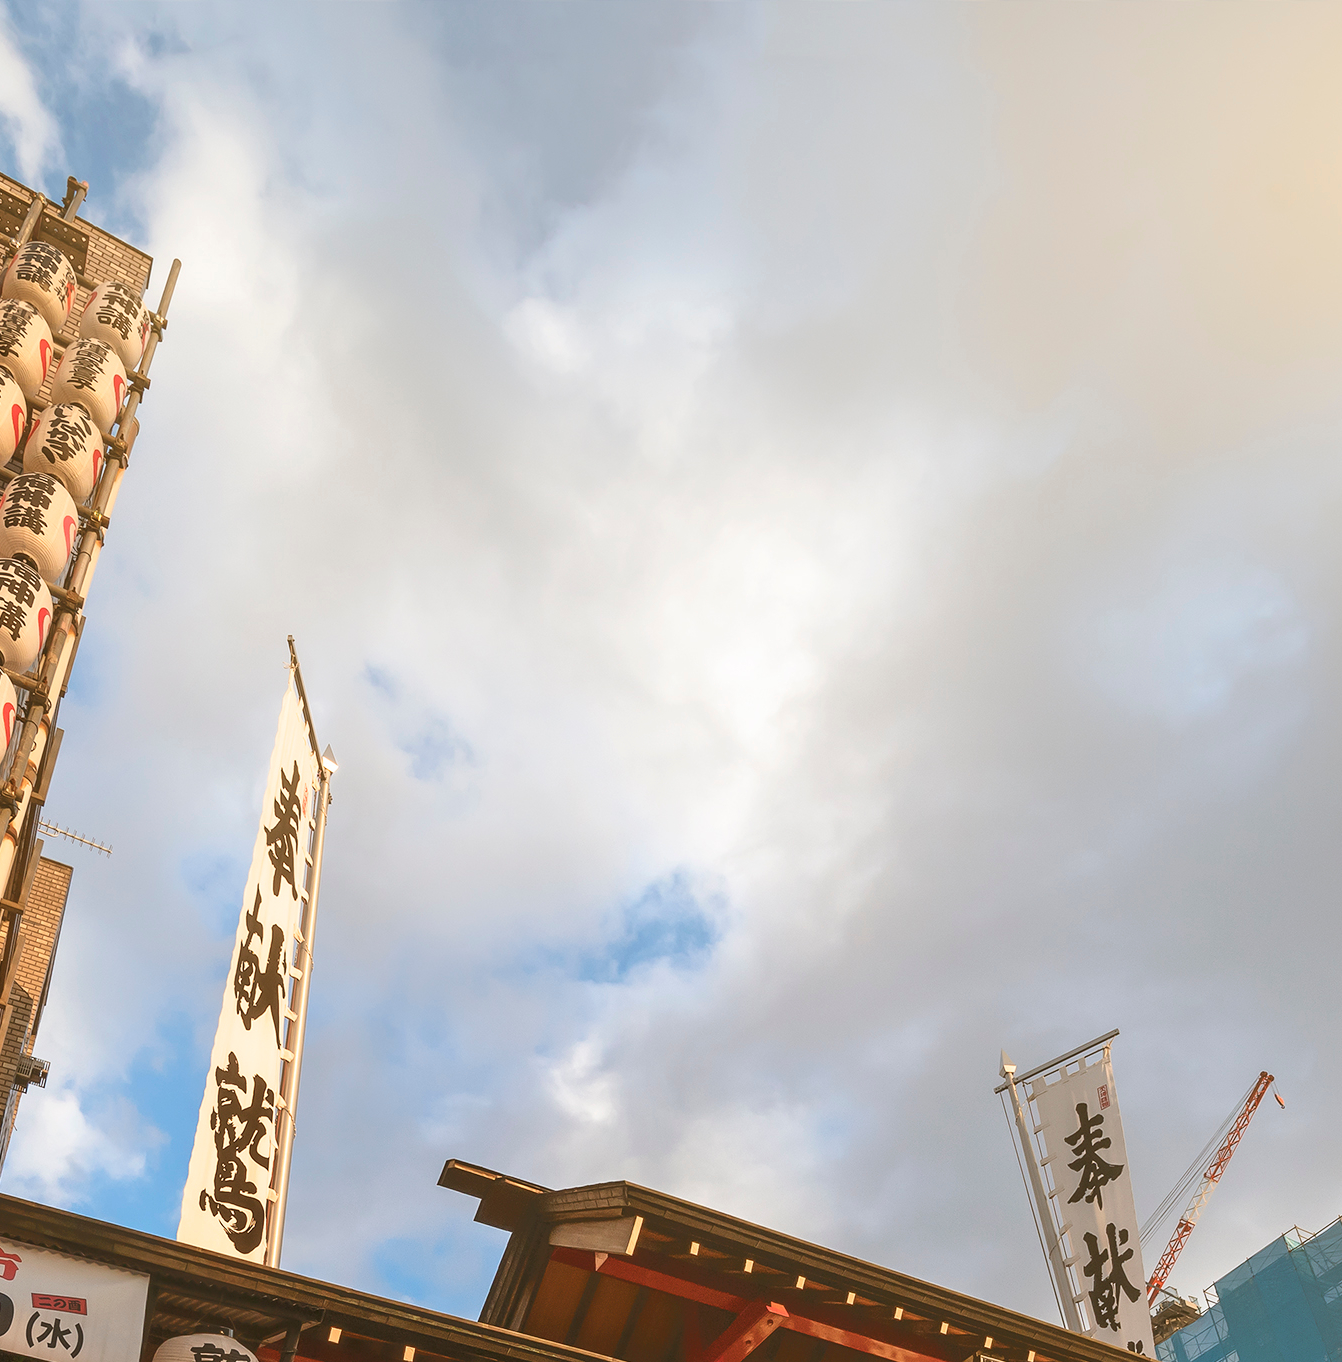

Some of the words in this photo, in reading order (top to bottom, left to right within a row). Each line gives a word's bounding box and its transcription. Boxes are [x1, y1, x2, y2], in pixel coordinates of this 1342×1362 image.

[2, 471, 58, 536] 福神講
[37, 1296, 86, 1314] 二の酉
